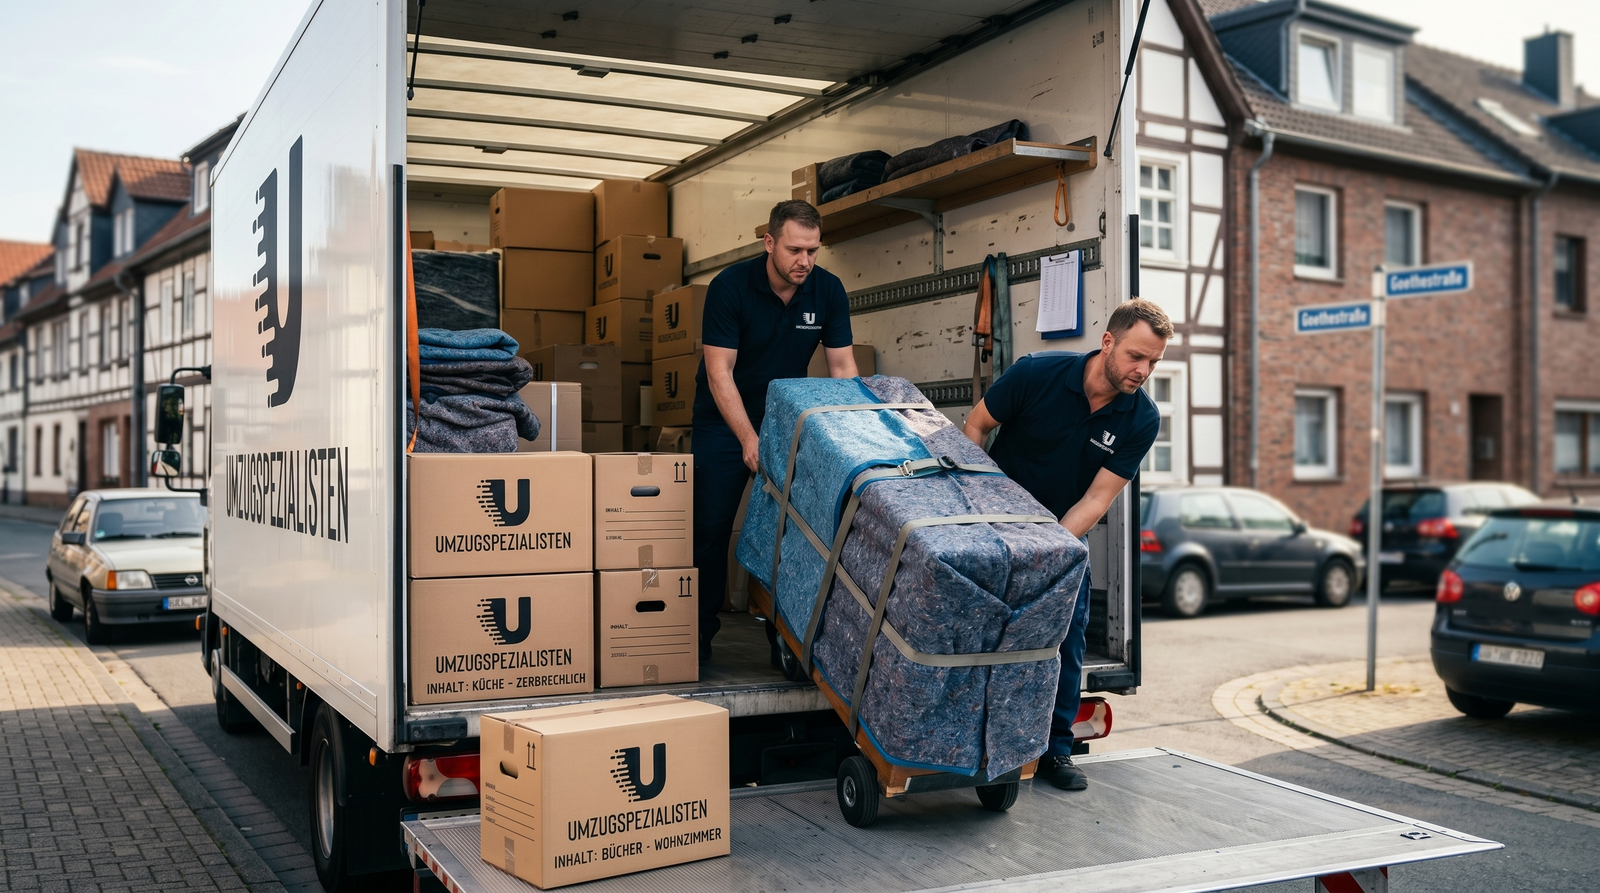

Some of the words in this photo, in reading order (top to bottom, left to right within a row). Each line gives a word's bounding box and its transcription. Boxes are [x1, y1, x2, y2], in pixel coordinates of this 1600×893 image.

[1390, 270, 1463, 292] Goethestraße
[803, 313, 815, 324] U
[1302, 308, 1367, 327] Goethestraße
[226, 447, 349, 543] UMZUGSPEZIALISTEN
[476, 479, 530, 526] U
[436, 532, 570, 553] UMZUGSPEZIALISTEN
[477, 597, 531, 645] U
[435, 649, 572, 674] UMZUGSPEZIALISTEN
[427, 682, 469, 695] INHALT:
[473, 678, 504, 691] KÜCHE
[516, 673, 585, 688] ZERBRECHLICH
[610, 743, 666, 802] U
[568, 799, 708, 842] UMZUGSPEZIALISTEN
[554, 850, 598, 869] INHALT:
[602, 842, 642, 860] BÜCHER
[654, 827, 722, 852] WOHNZIMMER
